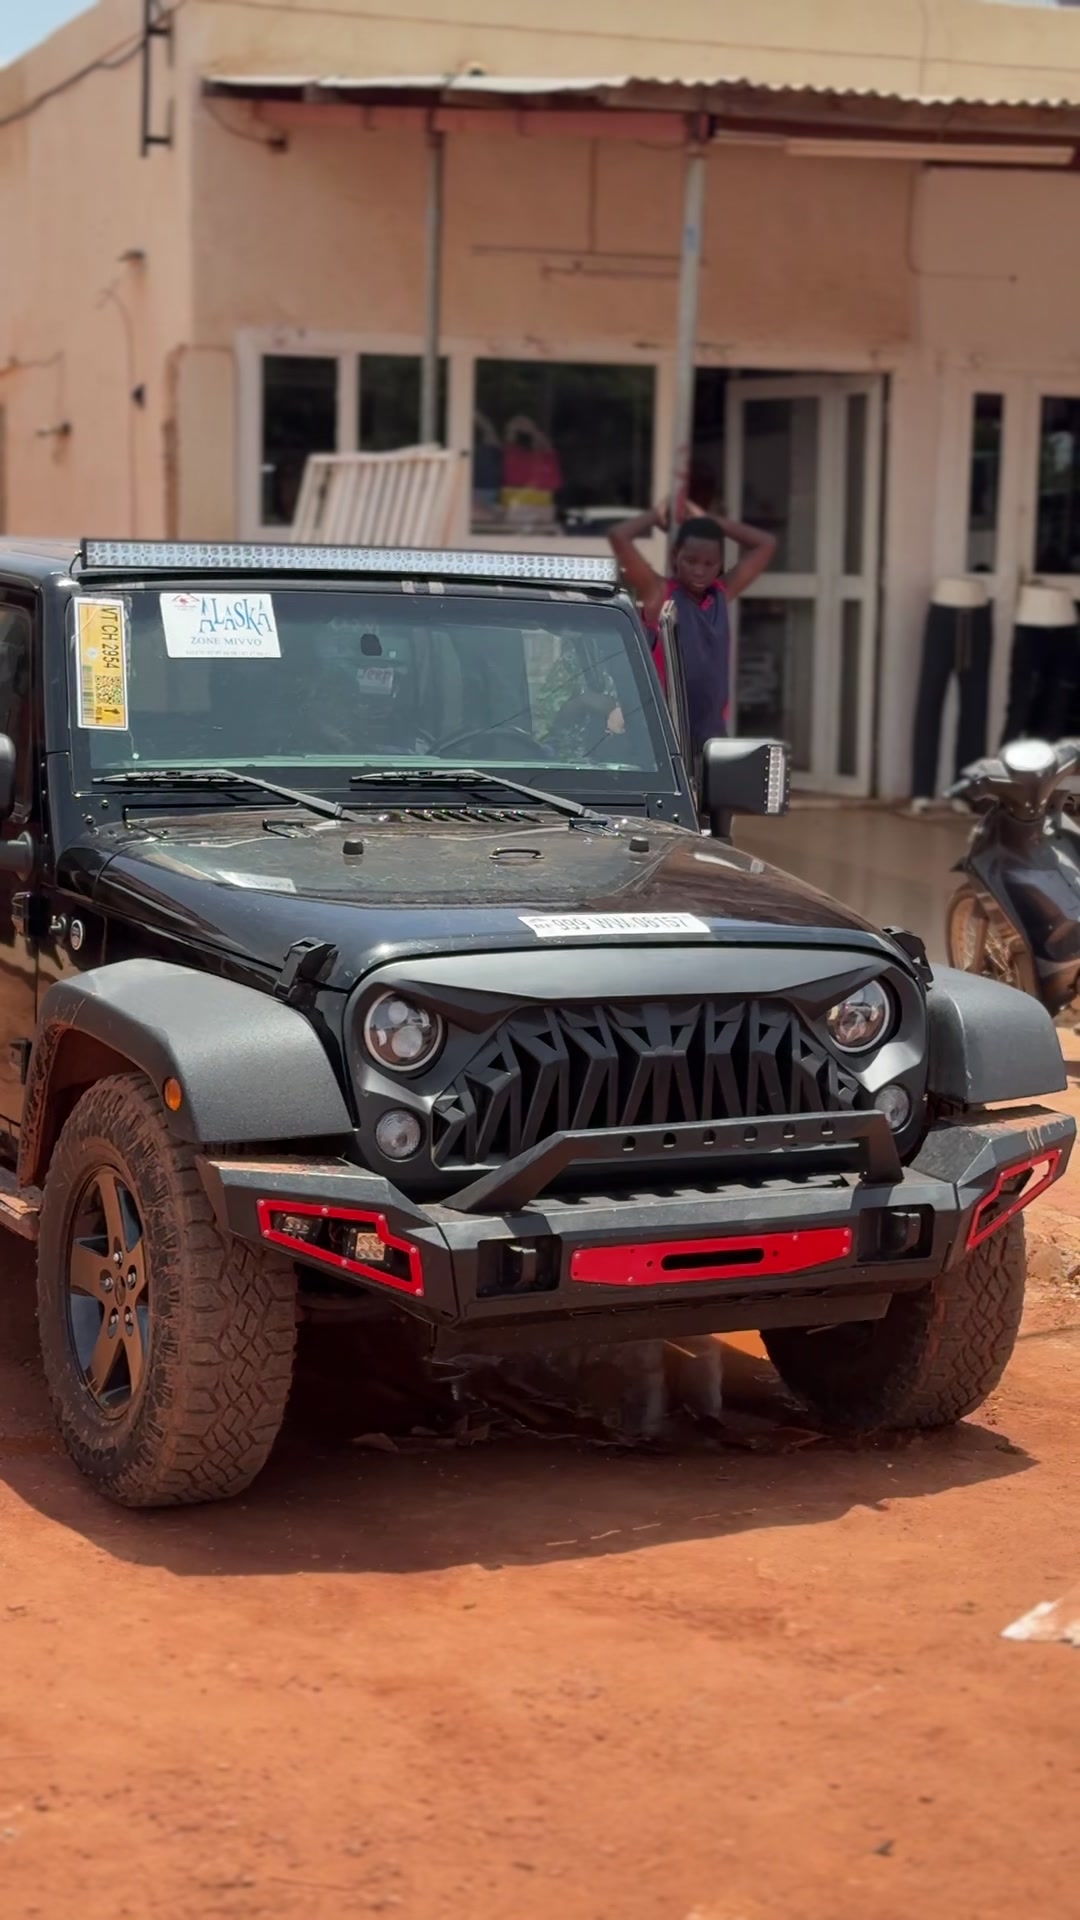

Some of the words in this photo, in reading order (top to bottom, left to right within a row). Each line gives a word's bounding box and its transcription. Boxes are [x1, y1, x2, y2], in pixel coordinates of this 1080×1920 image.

[101, 607, 118, 622] VT
[200, 597, 274, 636] ALASKA
[101, 625, 118, 640] CH
[190, 637, 221, 645] ZONE
[102, 643, 120, 669] 2954
[551, 919, 591, 931] 999
